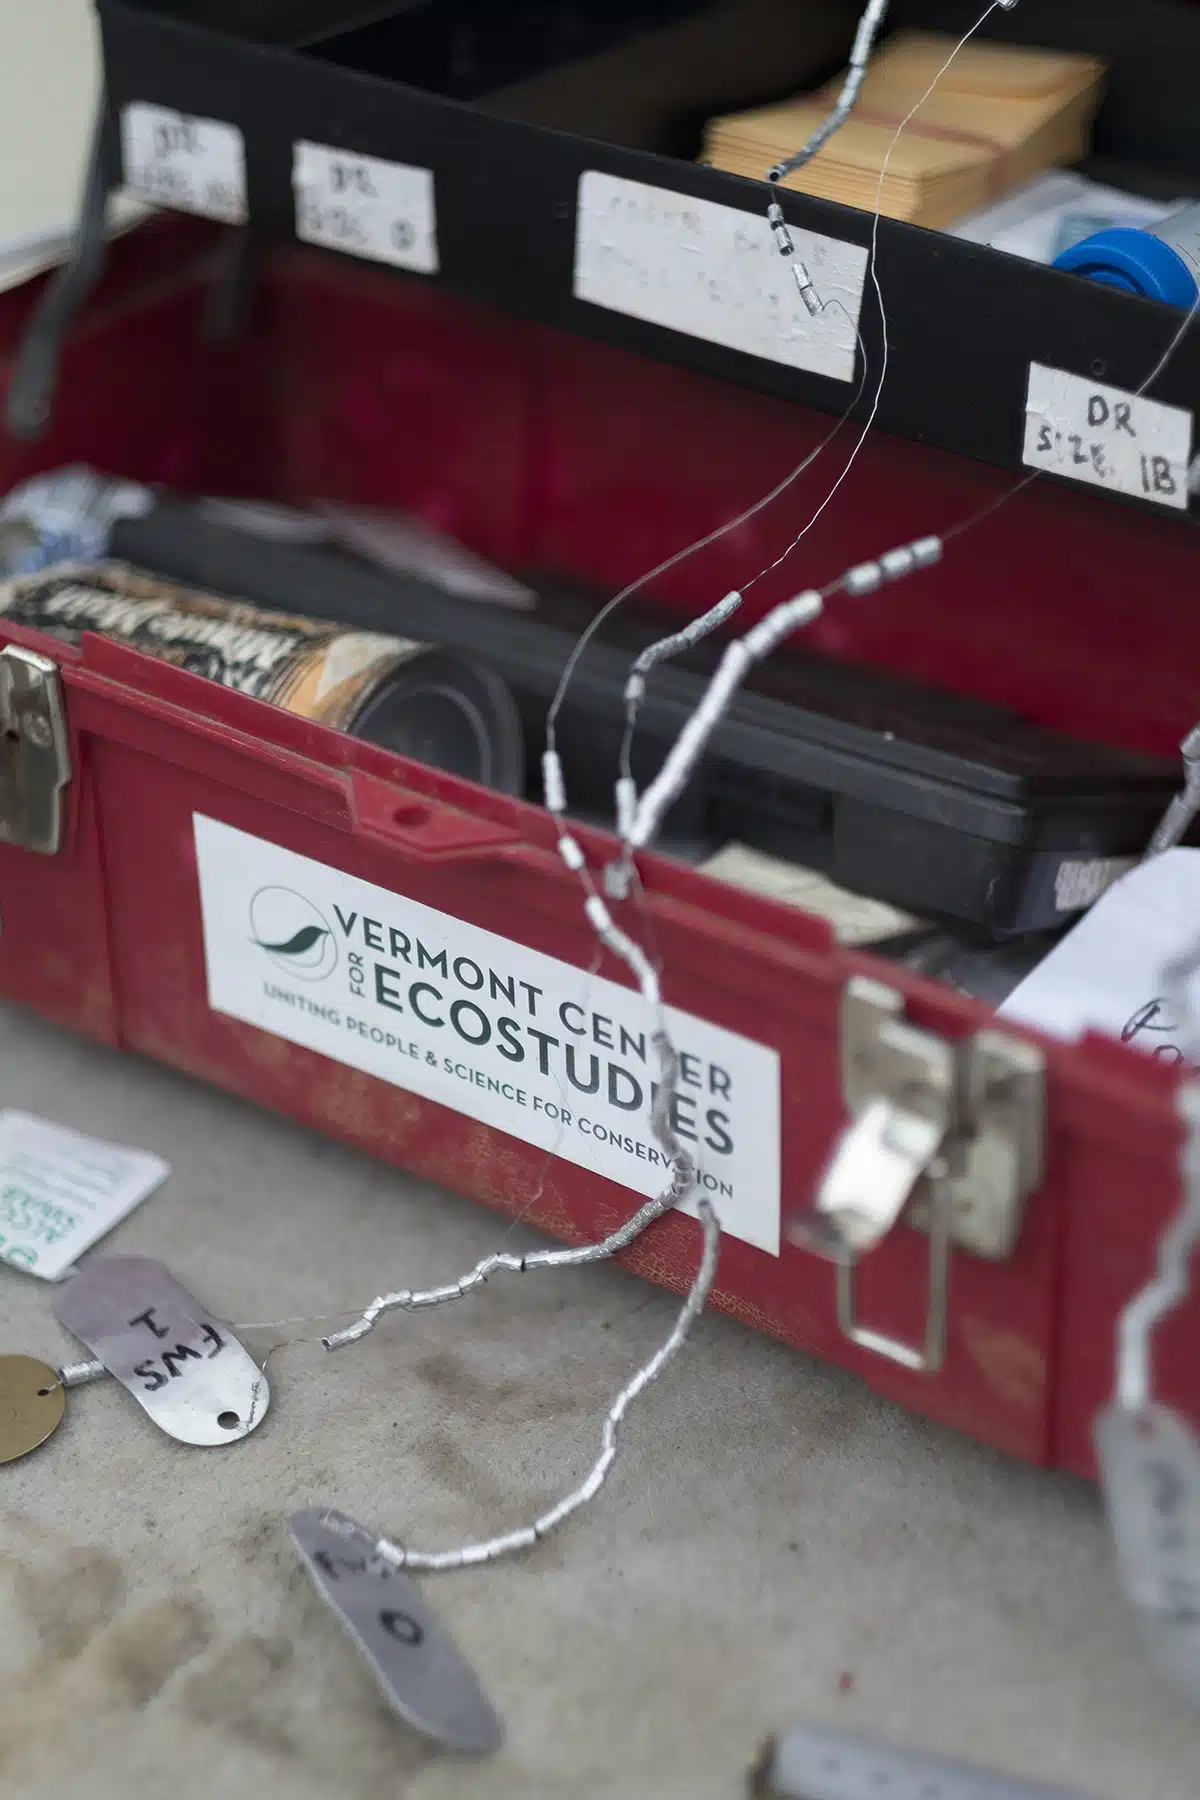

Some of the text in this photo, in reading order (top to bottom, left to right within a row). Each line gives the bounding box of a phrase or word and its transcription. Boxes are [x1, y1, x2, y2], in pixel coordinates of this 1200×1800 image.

[1088, 394, 1137, 438] DR
[332, 903, 733, 1102] VERMONT CENER
[347, 951, 366, 998] FOR
[262, 980, 734, 1200] UNITING PEOPLE & SCIENCE FOR CONSERVION
[133, 1322, 226, 1391] FWS
